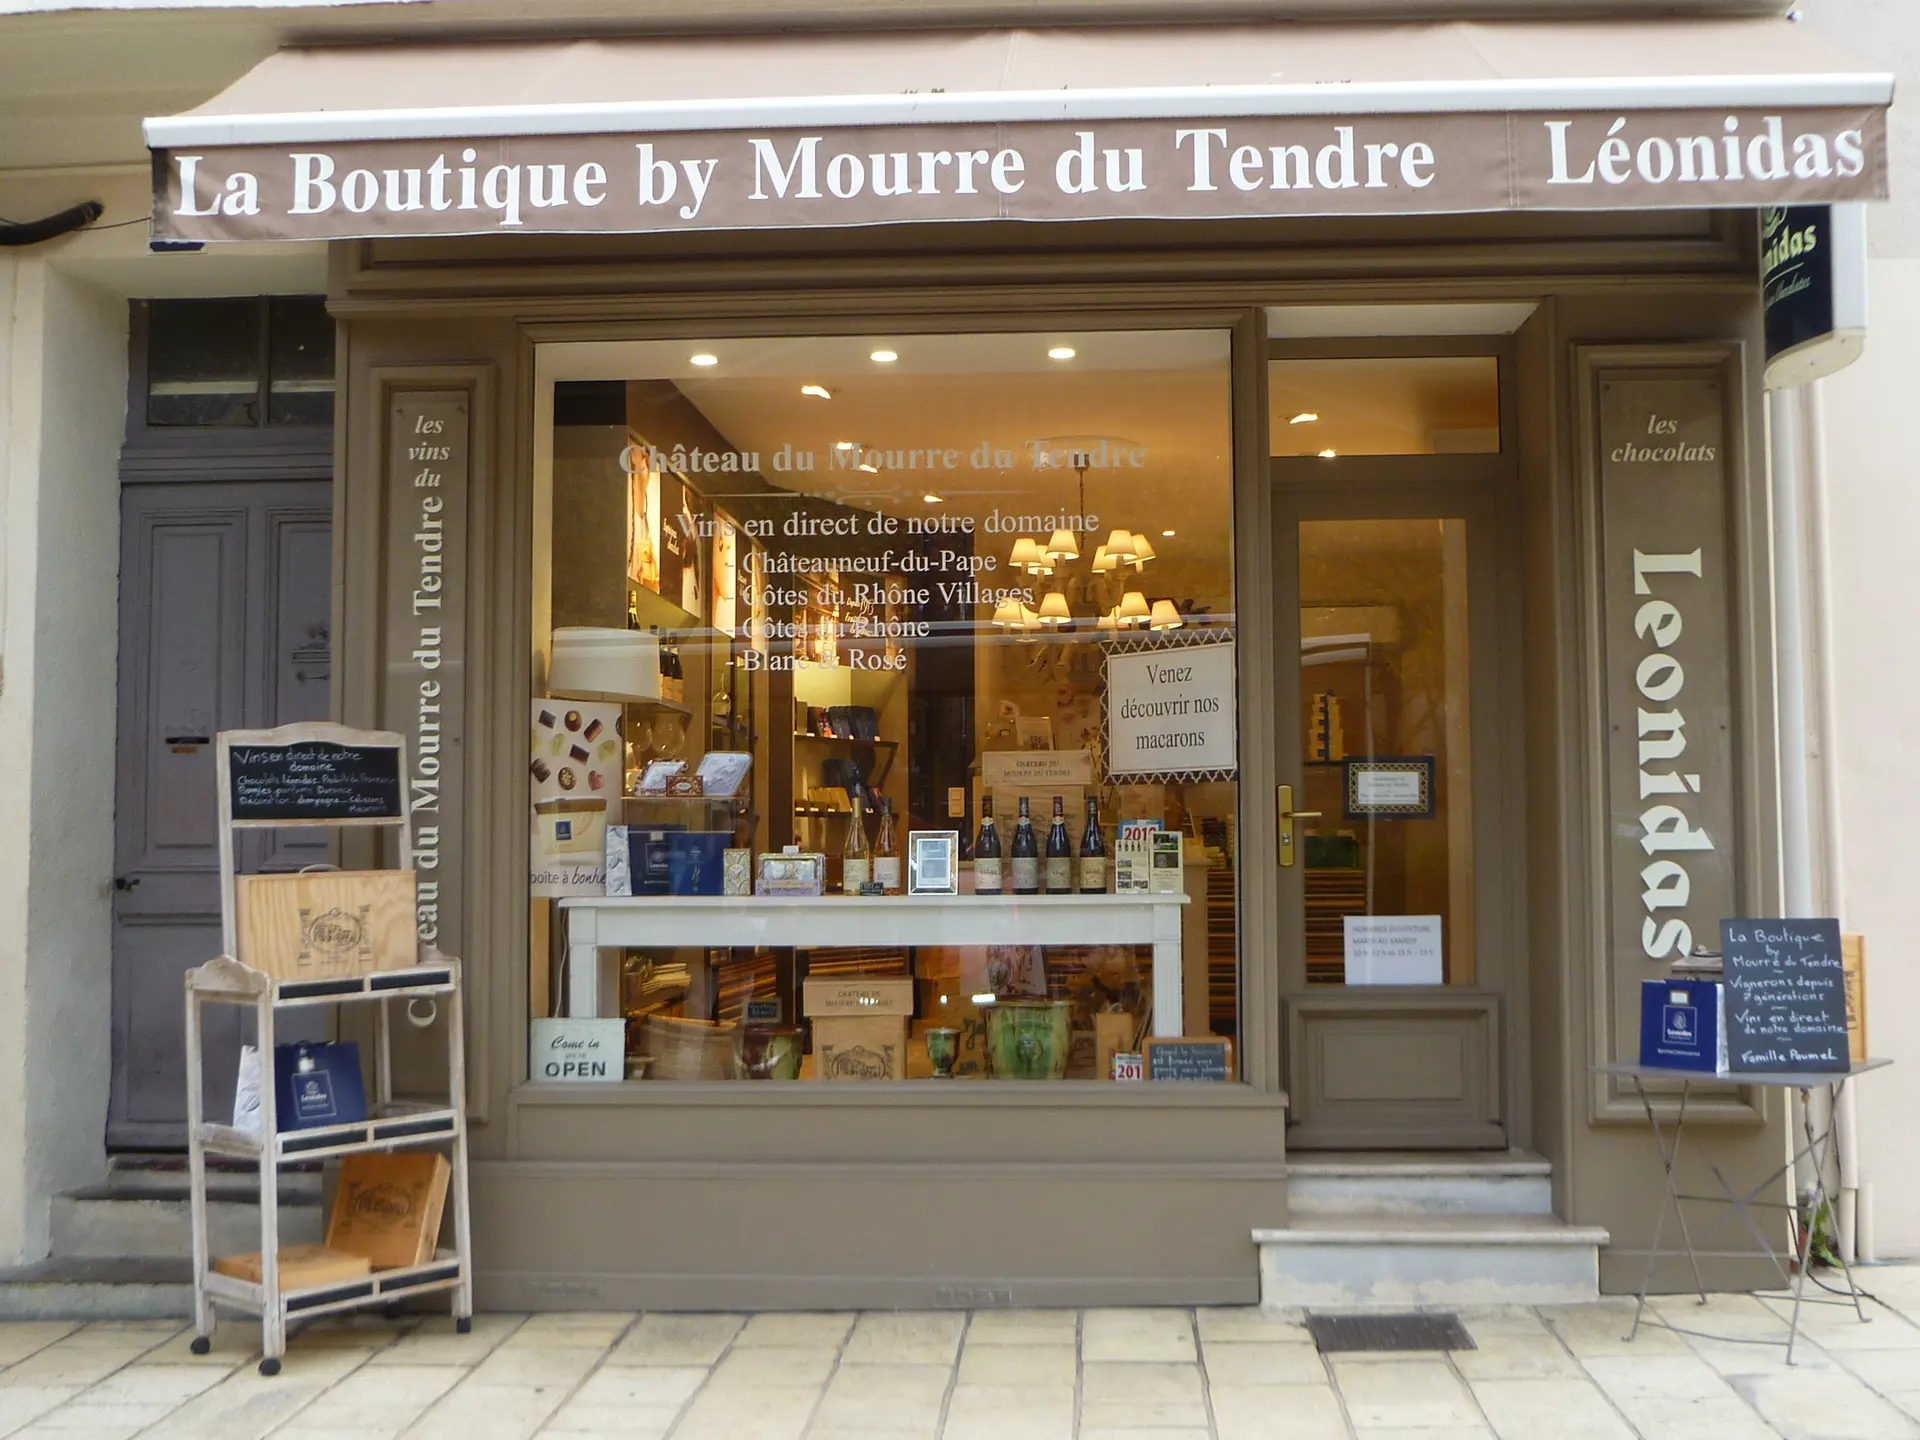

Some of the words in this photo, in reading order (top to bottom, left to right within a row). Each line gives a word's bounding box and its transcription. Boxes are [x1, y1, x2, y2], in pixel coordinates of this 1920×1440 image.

[174, 154, 260, 216] La
[287, 148, 607, 226] Boutique
[636, 142, 718, 219] by
[747, 136, 1025, 200] Mourre
[1055, 131, 1147, 194] du
[1175, 126, 1435, 191] Tendre
[1543, 115, 1865, 185] Léonidas
[414, 414, 444, 434] les
[1646, 415, 1677, 435] les
[408, 441, 451, 461] vins
[619, 440, 761, 474] Château
[772, 445, 814, 472] du
[828, 442, 960, 472] Mourre
[970, 440, 1013, 469] du
[1027, 439, 1146, 469] Tendre
[1611, 440, 1716, 463] chocolats
[414, 468, 441, 488] du
[675, 511, 736, 538] Vins
[743, 518, 775, 537] en
[783, 511, 857, 537] direct
[867, 510, 898, 536] de
[907, 512, 975, 535] notre
[984, 507, 1100, 534] domaine
[413, 495, 444, 616] Tendre
[742, 549, 997, 580] Châteauneuf-du-Pape
[743, 583, 808, 607] Côtes
[816, 583, 845, 605] du
[853, 581, 930, 605] Rhône
[936, 580, 1034, 608] Villages
[743, 615, 808, 639] Côtes
[853, 613, 930, 638] Rhône
[412, 626, 441, 670] du
[743, 649, 811, 671] Blanc
[848, 647, 908, 672] Rosé
[1146, 664, 1193, 685] Venez
[1120, 694, 1190, 719] découvrir
[1194, 696, 1219, 713] nos
[411, 680, 441, 814] Mourre
[1136, 731, 1205, 750] macarons
[412, 825, 439, 870] du
[1729, 928, 1747, 943] La
[1754, 927, 1825, 950] Boutique
[1765, 944, 1780, 956] by
[1733, 956, 1780, 968] Mourre
[1799, 954, 1842, 969] Tendre
[1730, 975, 1793, 991] Vignerons
[1796, 975, 1834, 990] depuis
[551, 1034, 585, 1050] Come
[588, 1038, 601, 1049] in
[1741, 1048, 1786, 1064] Famille
[545, 1061, 606, 1077] OPEN
